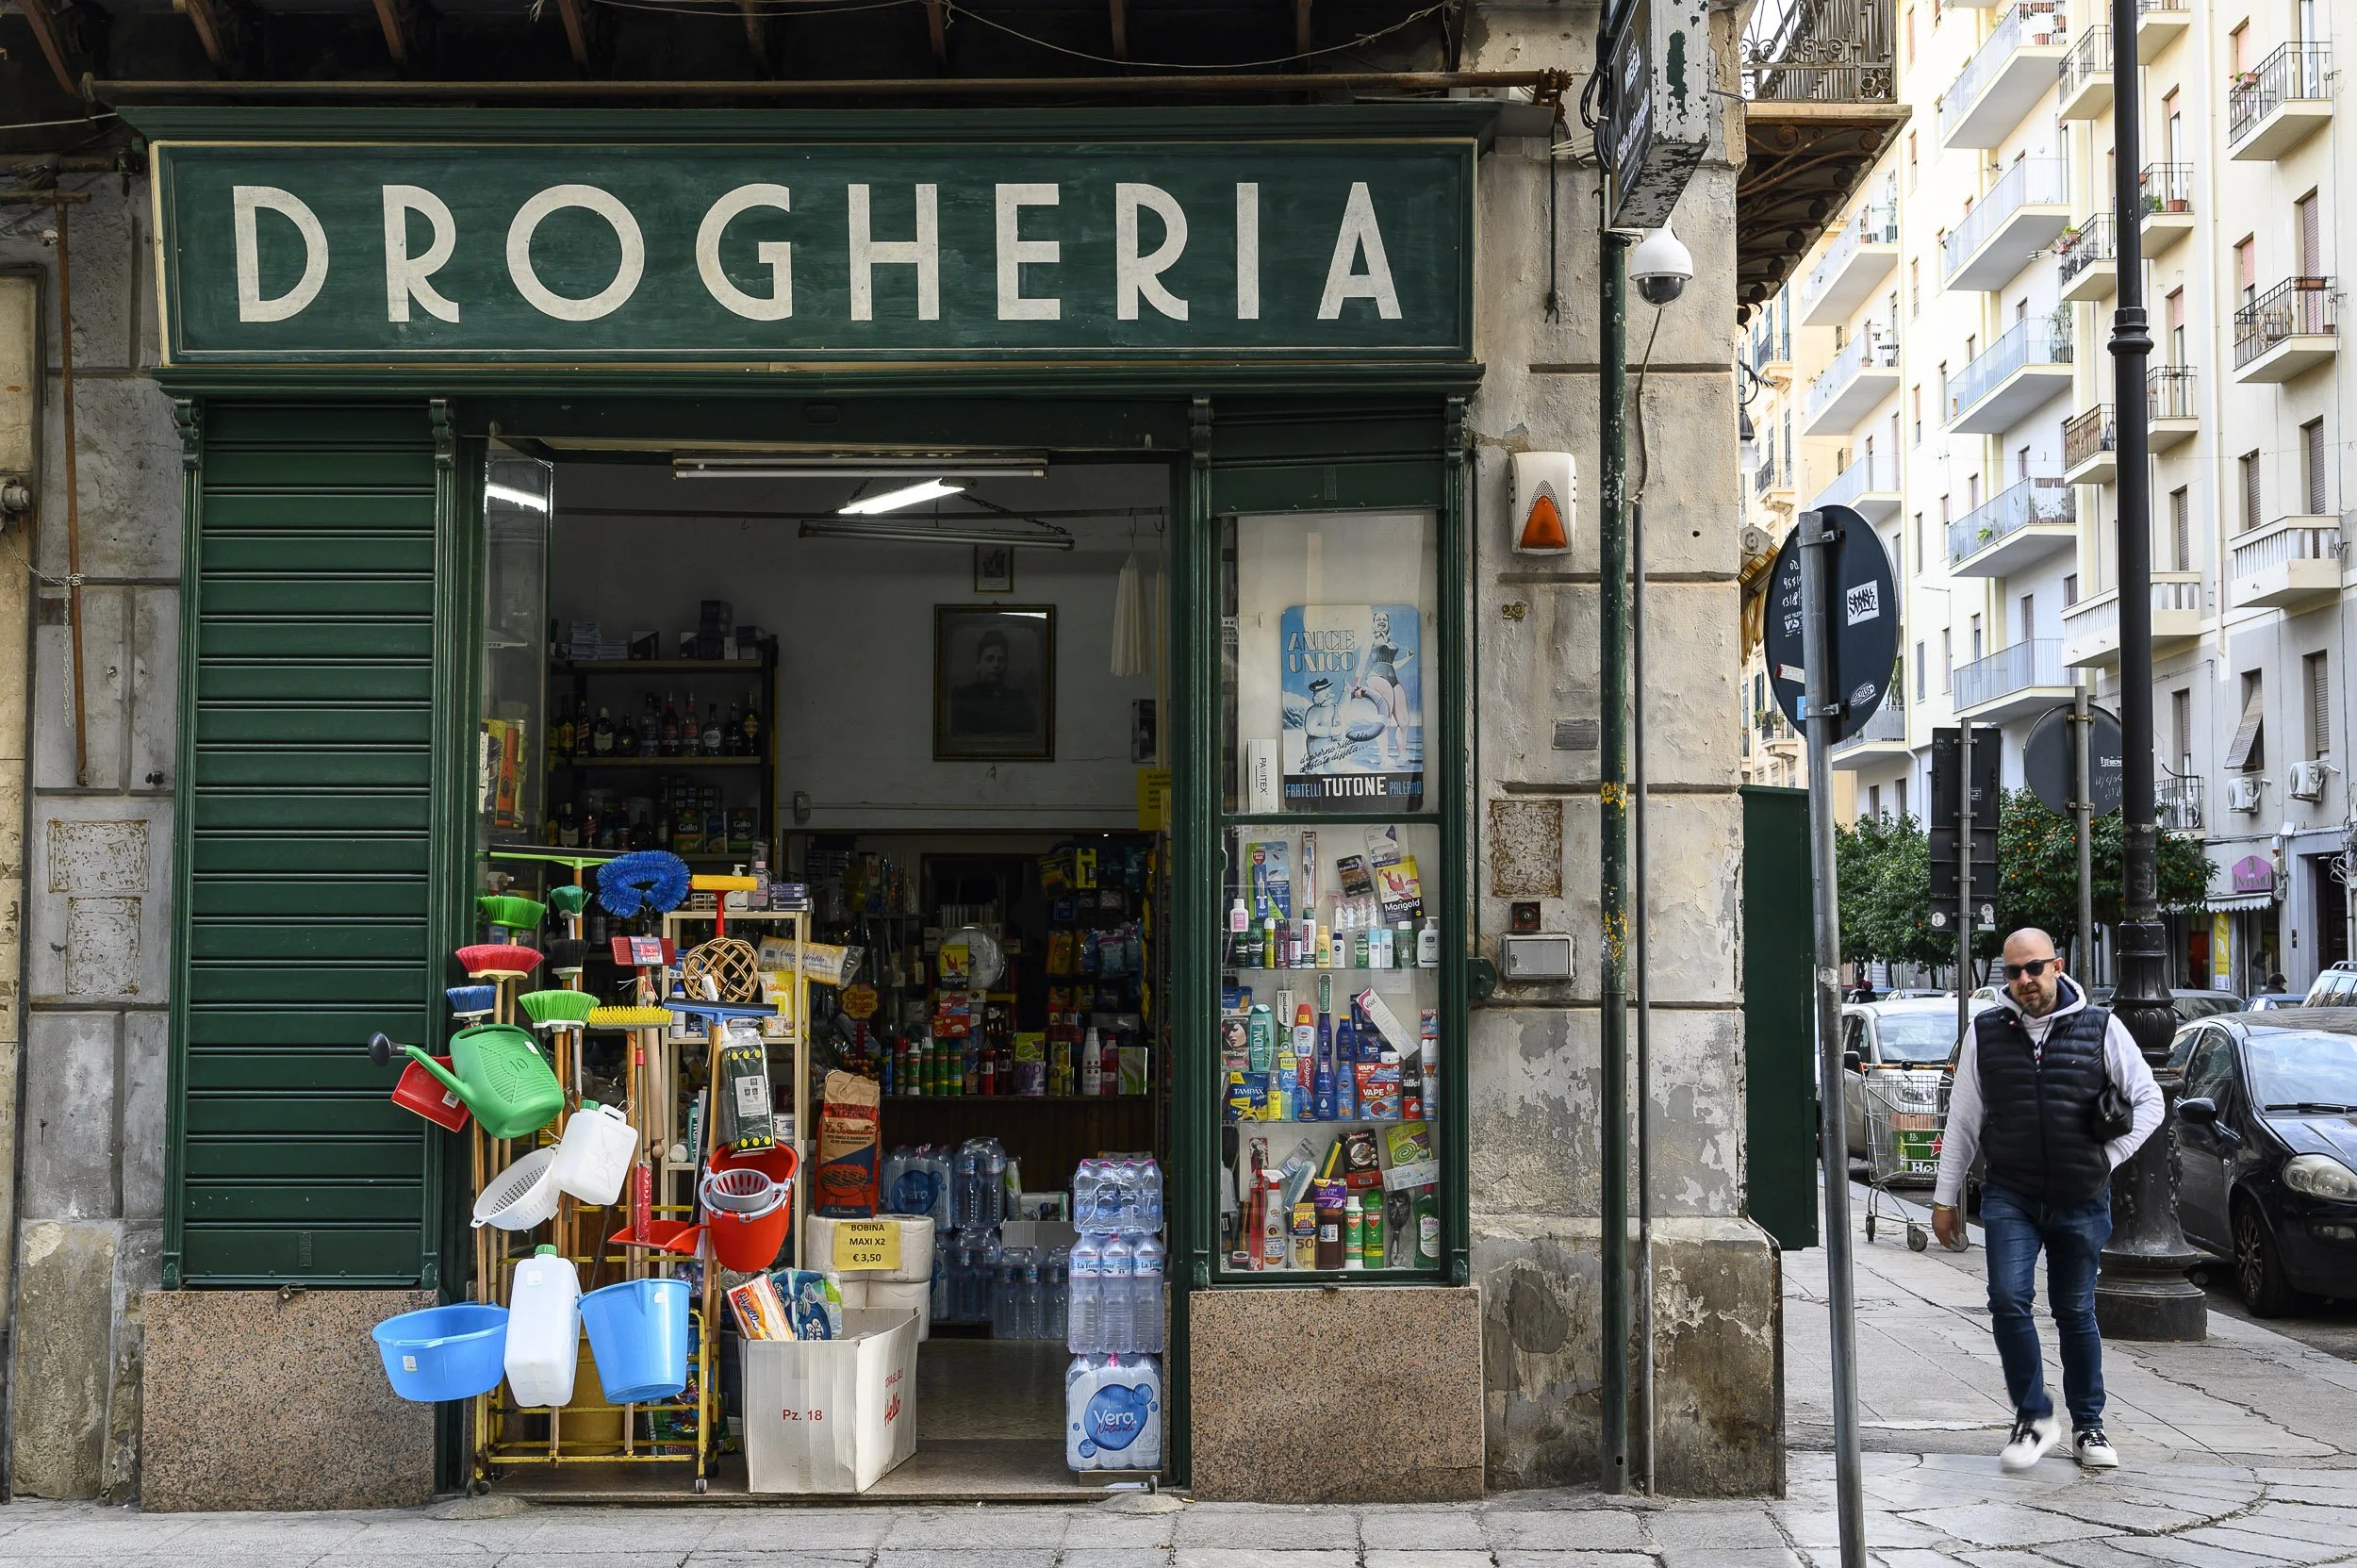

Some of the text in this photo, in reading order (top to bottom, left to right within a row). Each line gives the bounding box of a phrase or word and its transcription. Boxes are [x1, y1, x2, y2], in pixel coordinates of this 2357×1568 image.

[233, 182, 1402, 323] DROGHERIA
[1287, 630, 1355, 652] ANICE
[1289, 652, 1355, 673] UNICO
[1322, 776, 1387, 797] TUTONE
[1389, 781, 1422, 797] PALERMO
[733, 820, 750, 829] Gallo
[2233, 872, 2270, 889] INTIMO
[1384, 899, 1421, 913] Marigold
[847, 991, 873, 1000] Chupa
[846, 999, 873, 1012] Chups
[1253, 1028, 1263, 1052] VIDAL
[1282, 1071, 1295, 1080] AZ
[831, 1102, 870, 1113] CARBONE
[1911, 1162, 1938, 1174] Hei
[1295, 1238, 1313, 1249] 50
[861, 1253, 882, 1263] 3,50
[737, 1292, 760, 1331] Hello
[783, 1410, 823, 1421] Pz. 18
[884, 1391, 901, 1428] Hello
[1095, 1420, 1135, 1436] Naturale
